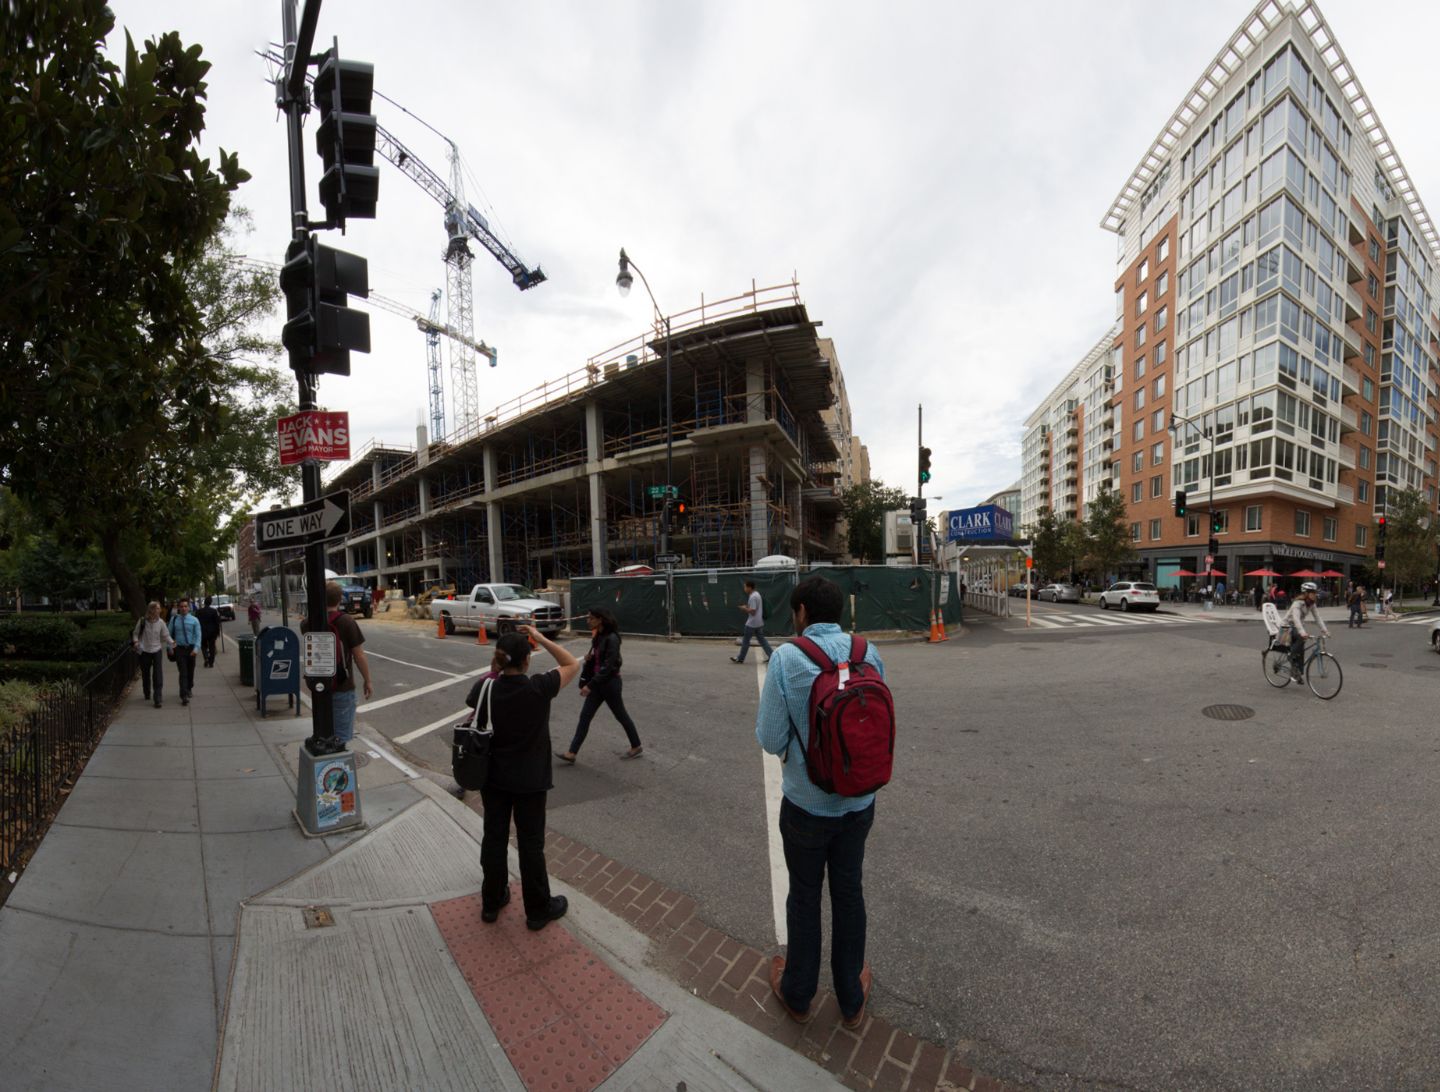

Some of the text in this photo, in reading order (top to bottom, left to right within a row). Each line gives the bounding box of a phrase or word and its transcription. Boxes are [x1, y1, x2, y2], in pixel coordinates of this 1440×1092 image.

[280, 415, 313, 433] JACK
[280, 428, 348, 450] EVANS
[295, 445, 308, 455] FOR
[266, 511, 324, 538] ONE WAY
[950, 511, 991, 529] CLARK
[950, 527, 991, 537] CONSTRUCTION
